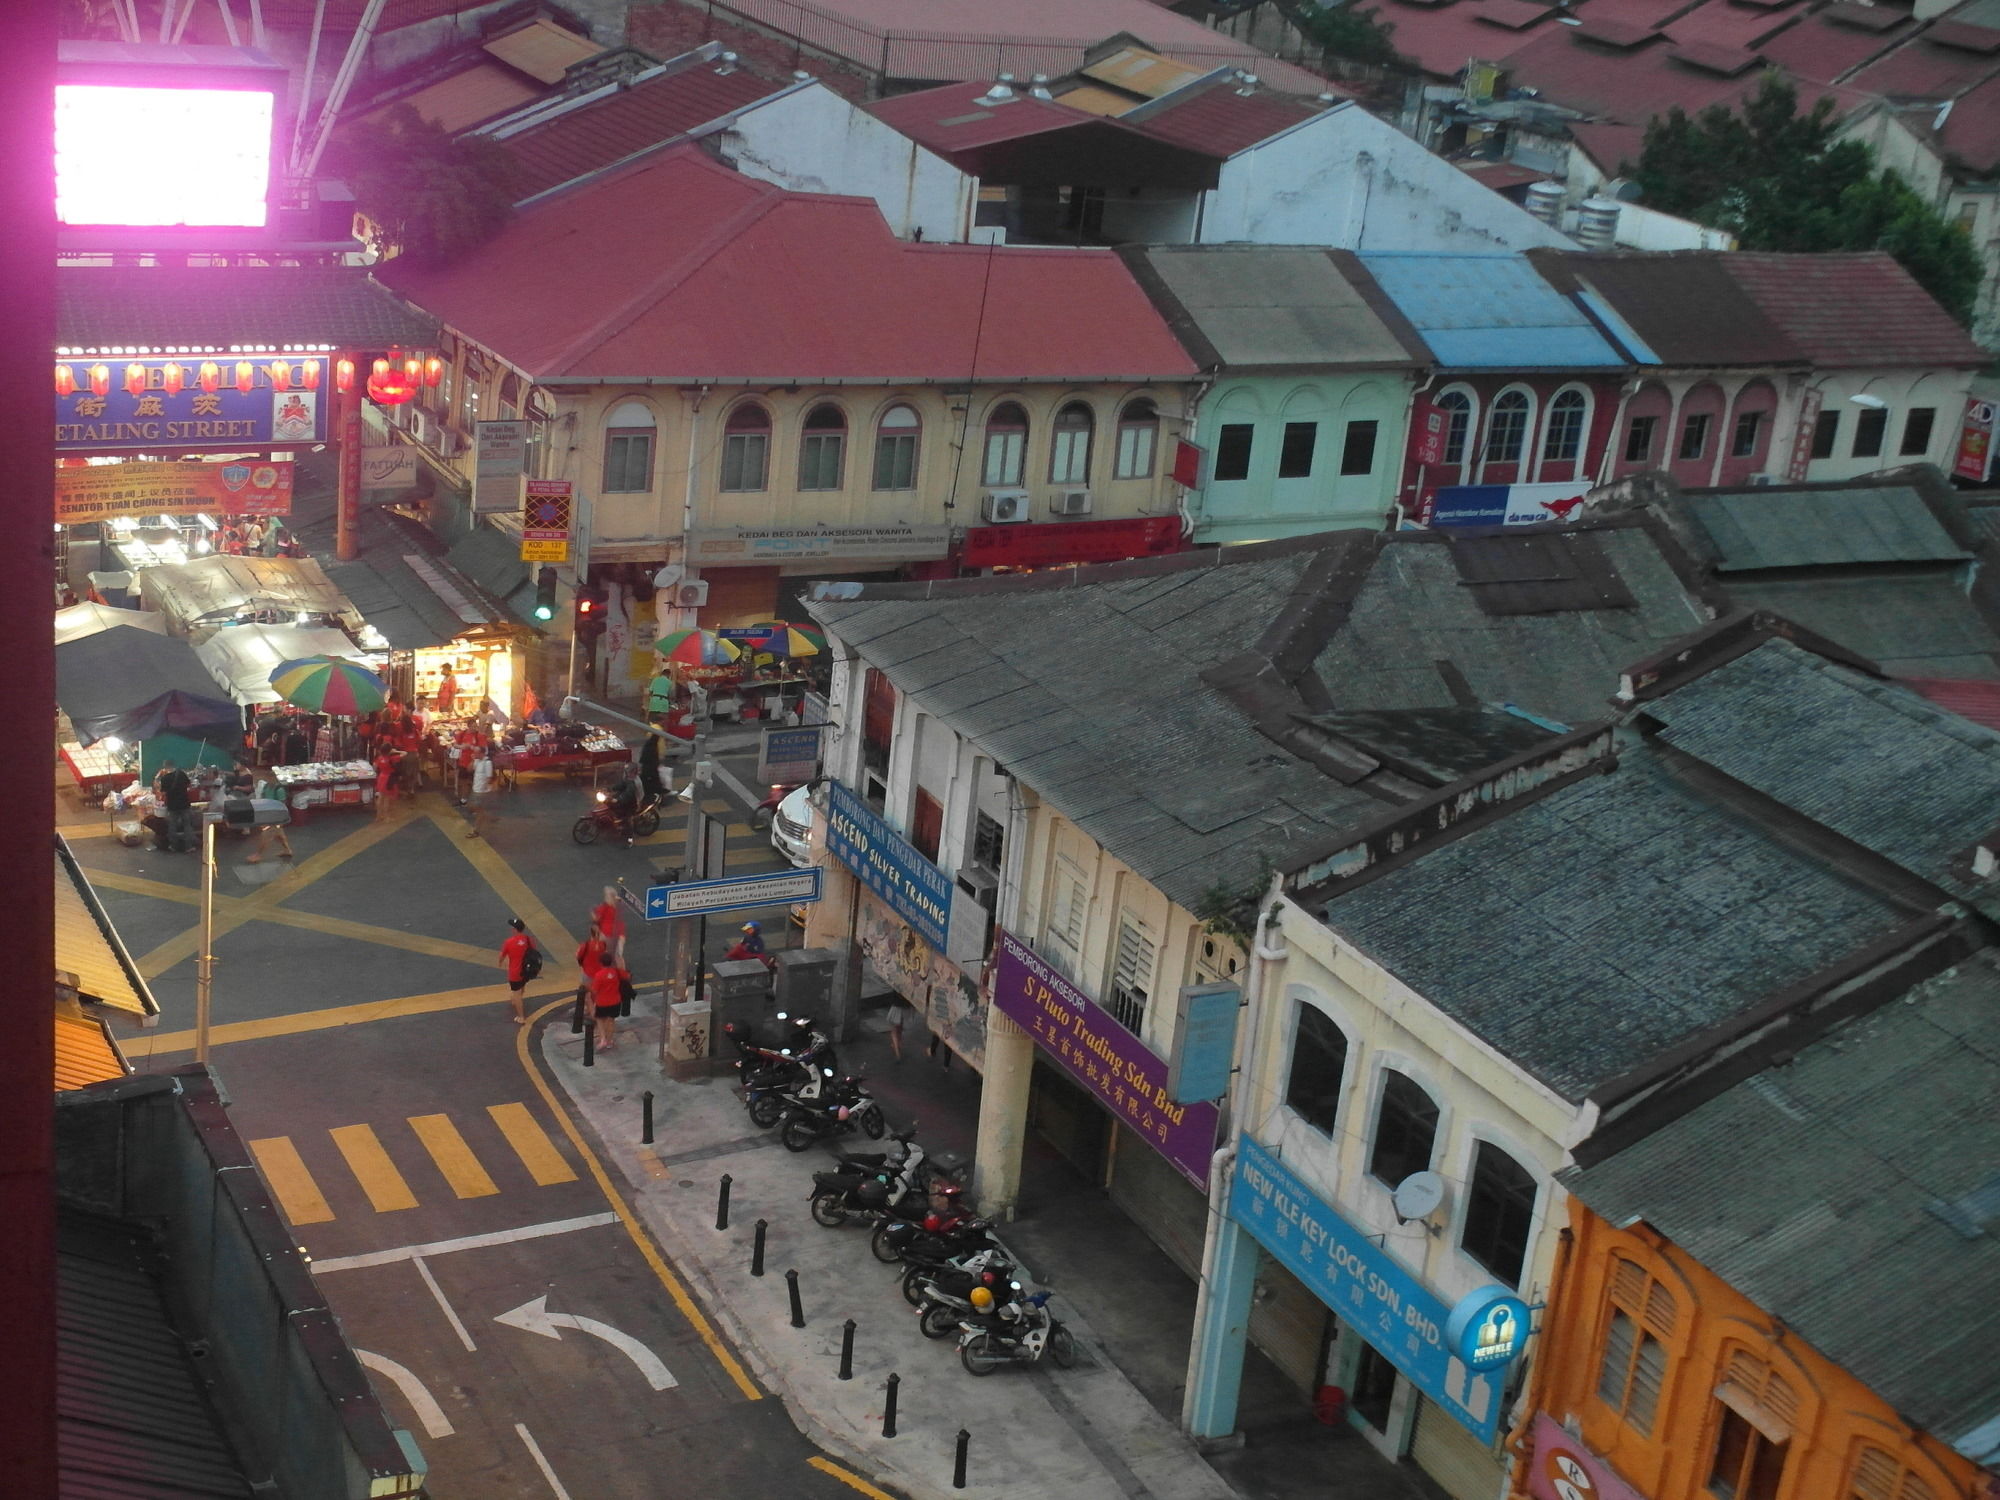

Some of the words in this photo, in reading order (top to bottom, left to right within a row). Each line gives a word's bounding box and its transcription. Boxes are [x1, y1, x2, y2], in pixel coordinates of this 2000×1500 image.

[56, 422, 160, 442] ETALING
[166, 420, 257, 439] STREET
[59, 501, 103, 514] SENATOR
[1508, 513, 1520, 522] da
[821, 529, 873, 537] AKSESORI
[876, 528, 913, 536] WANITA
[528, 541, 544, 549] KOD
[772, 734, 816, 745] ASCEND
[832, 784, 871, 833] PEMBORONG
[922, 866, 947, 901] PERAK
[830, 808, 869, 853] ASCEND
[869, 848, 900, 887] SILVER
[904, 880, 945, 926] TRADING
[1003, 936, 1048, 984] PEMBORONG
[1049, 974, 1086, 1016] AKSESORI
[1023, 976, 1037, 1000] S
[1035, 989, 1071, 1030] Pluto
[1071, 1015, 1125, 1080] Trading
[1124, 1060, 1152, 1101] Sdn
[1242, 1160, 1274, 1202] NEW
[1274, 1193, 1299, 1226] KLE
[1299, 1211, 1329, 1252] KEY
[1328, 1237, 1369, 1286] LOCK
[1367, 1272, 1404, 1322] SDN.
[1404, 1302, 1444, 1352] BHD.
[1569, 1462, 1580, 1482] R
